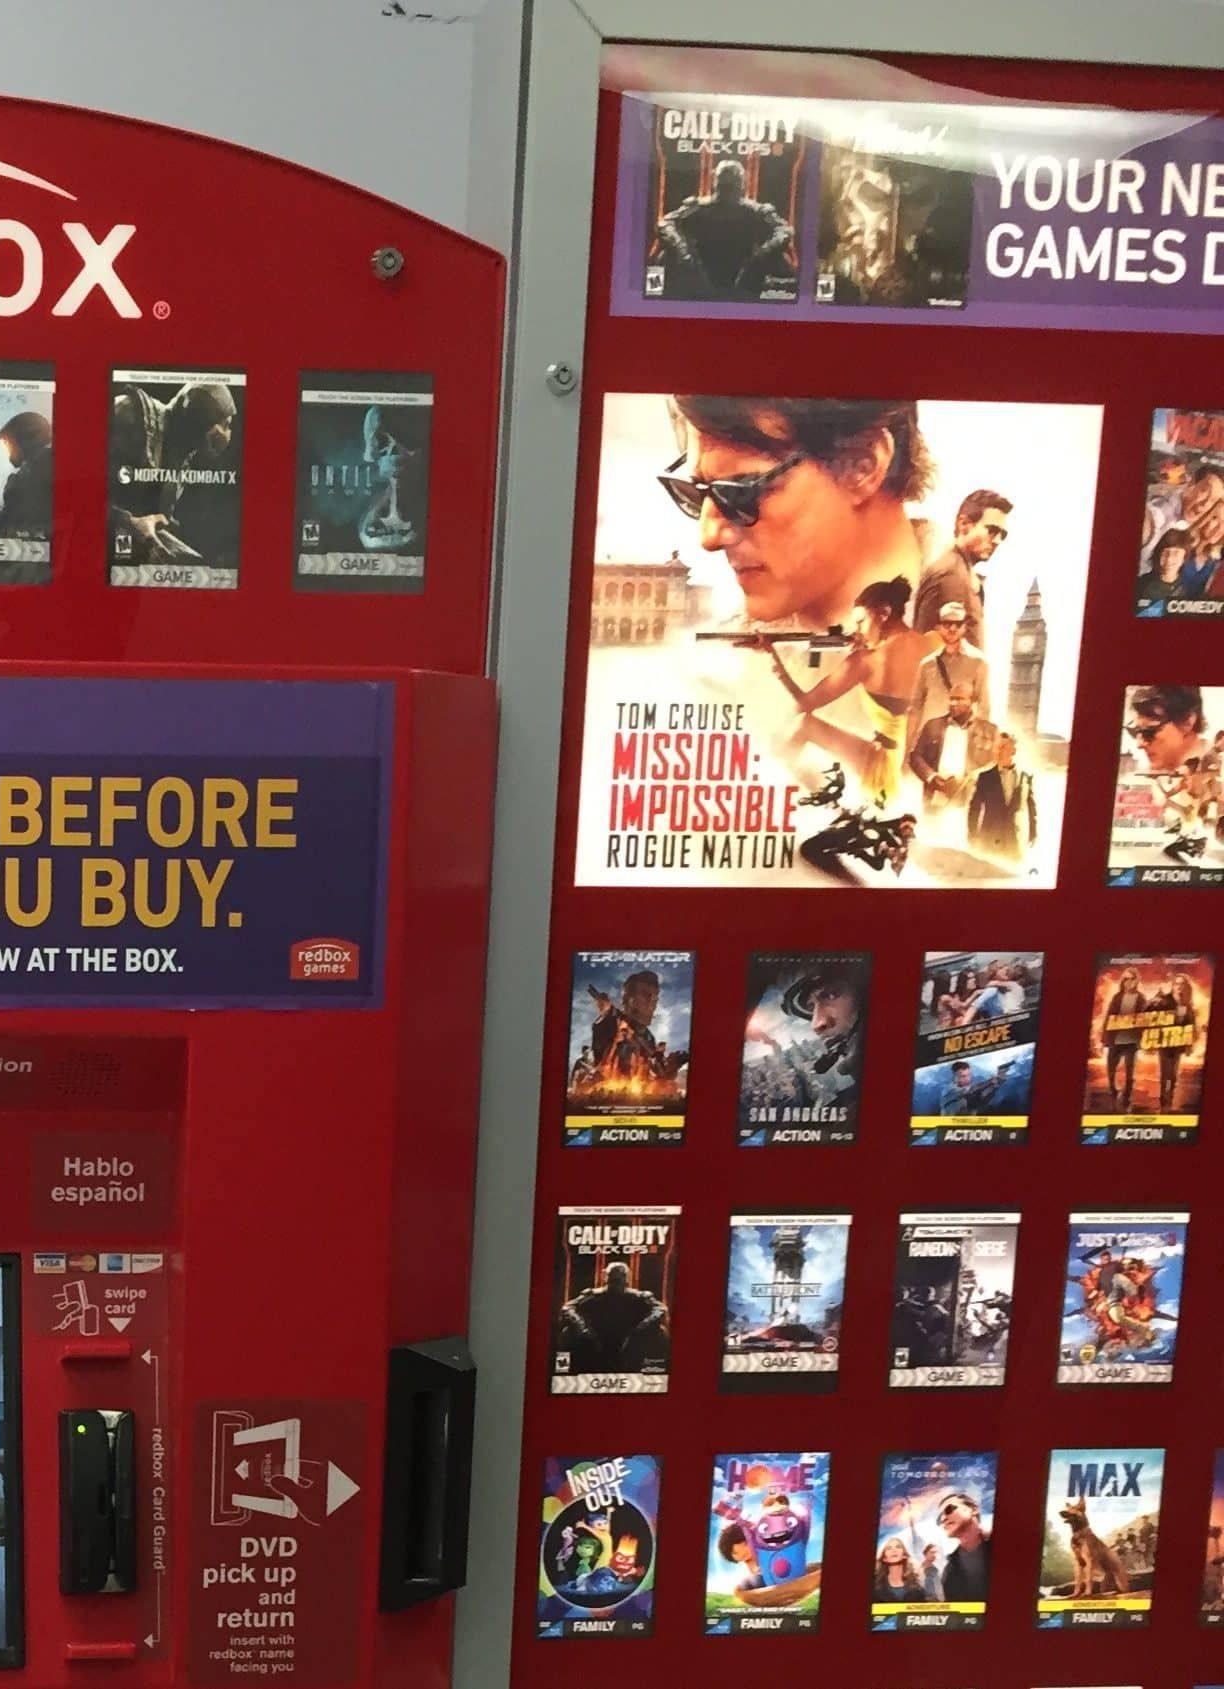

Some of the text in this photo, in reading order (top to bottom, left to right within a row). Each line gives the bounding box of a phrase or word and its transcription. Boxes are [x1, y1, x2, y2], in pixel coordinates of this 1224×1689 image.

[664, 110, 721, 139] CALL
[991, 153, 1145, 214] YOUR
[986, 224, 1186, 284] GAMES
[134, 468, 236, 484] MORTAL KOMBAT X
[312, 465, 373, 487] UNTIL
[340, 557, 380, 571] GAME
[153, 569, 193, 583] GAME
[616, 702, 745, 731] TOM CRUISE
[612, 732, 760, 782] MISSION:
[609, 783, 799, 832] IMPOSSIBLE
[606, 834, 795, 869] ROGUE NATION
[1141, 870, 1192, 882] ACTION
[80, 857, 243, 928] BUY.
[27, 948, 60, 972] AT
[65, 948, 117, 972] THE
[124, 948, 184, 973] BOX.
[298, 948, 351, 964] redbox
[578, 952, 690, 962] TERMINATOR
[303, 962, 346, 977] games
[944, 1035, 963, 1054] NO
[964, 1024, 1013, 1049] ESCAPE
[749, 1107, 848, 1122] SAN ANDREAS
[600, 1129, 649, 1141] ACTION
[772, 1129, 821, 1142] ACTION
[944, 1129, 993, 1141] ACTION
[1115, 1128, 1164, 1140] ACTION
[63, 1156, 134, 1177] Hablo
[50, 1179, 145, 1205] español
[568, 1225, 669, 1246] CALL DUTY
[578, 1245, 648, 1255] BLACK OPS
[40, 1259, 61, 1267] VISA
[104, 1287, 147, 1301] swipe
[104, 1302, 136, 1314] card
[761, 1357, 799, 1368] GAME
[927, 1370, 964, 1383] GAME
[1096, 1367, 1133, 1379] GAME
[590, 1378, 628, 1390] GAME
[566, 1456, 632, 1497] INSIDE
[1067, 1462, 1144, 1498] MAX
[152, 1427, 166, 1571] redbox Card Guard
[584, 1479, 626, 1513] OUT
[240, 1537, 297, 1558] DVD
[203, 1564, 296, 1588] pick up
[258, 1590, 296, 1605] and
[217, 1611, 295, 1628] return
[740, 1618, 784, 1629] FAMILY
[906, 1614, 949, 1626] FAMILY
[1072, 1612, 1116, 1623] FAMILY
[573, 1620, 616, 1633] FAMILY
[230, 1635, 294, 1646] insert with
[209, 1649, 294, 1660] redbox name
[230, 1662, 294, 1674] facing you
